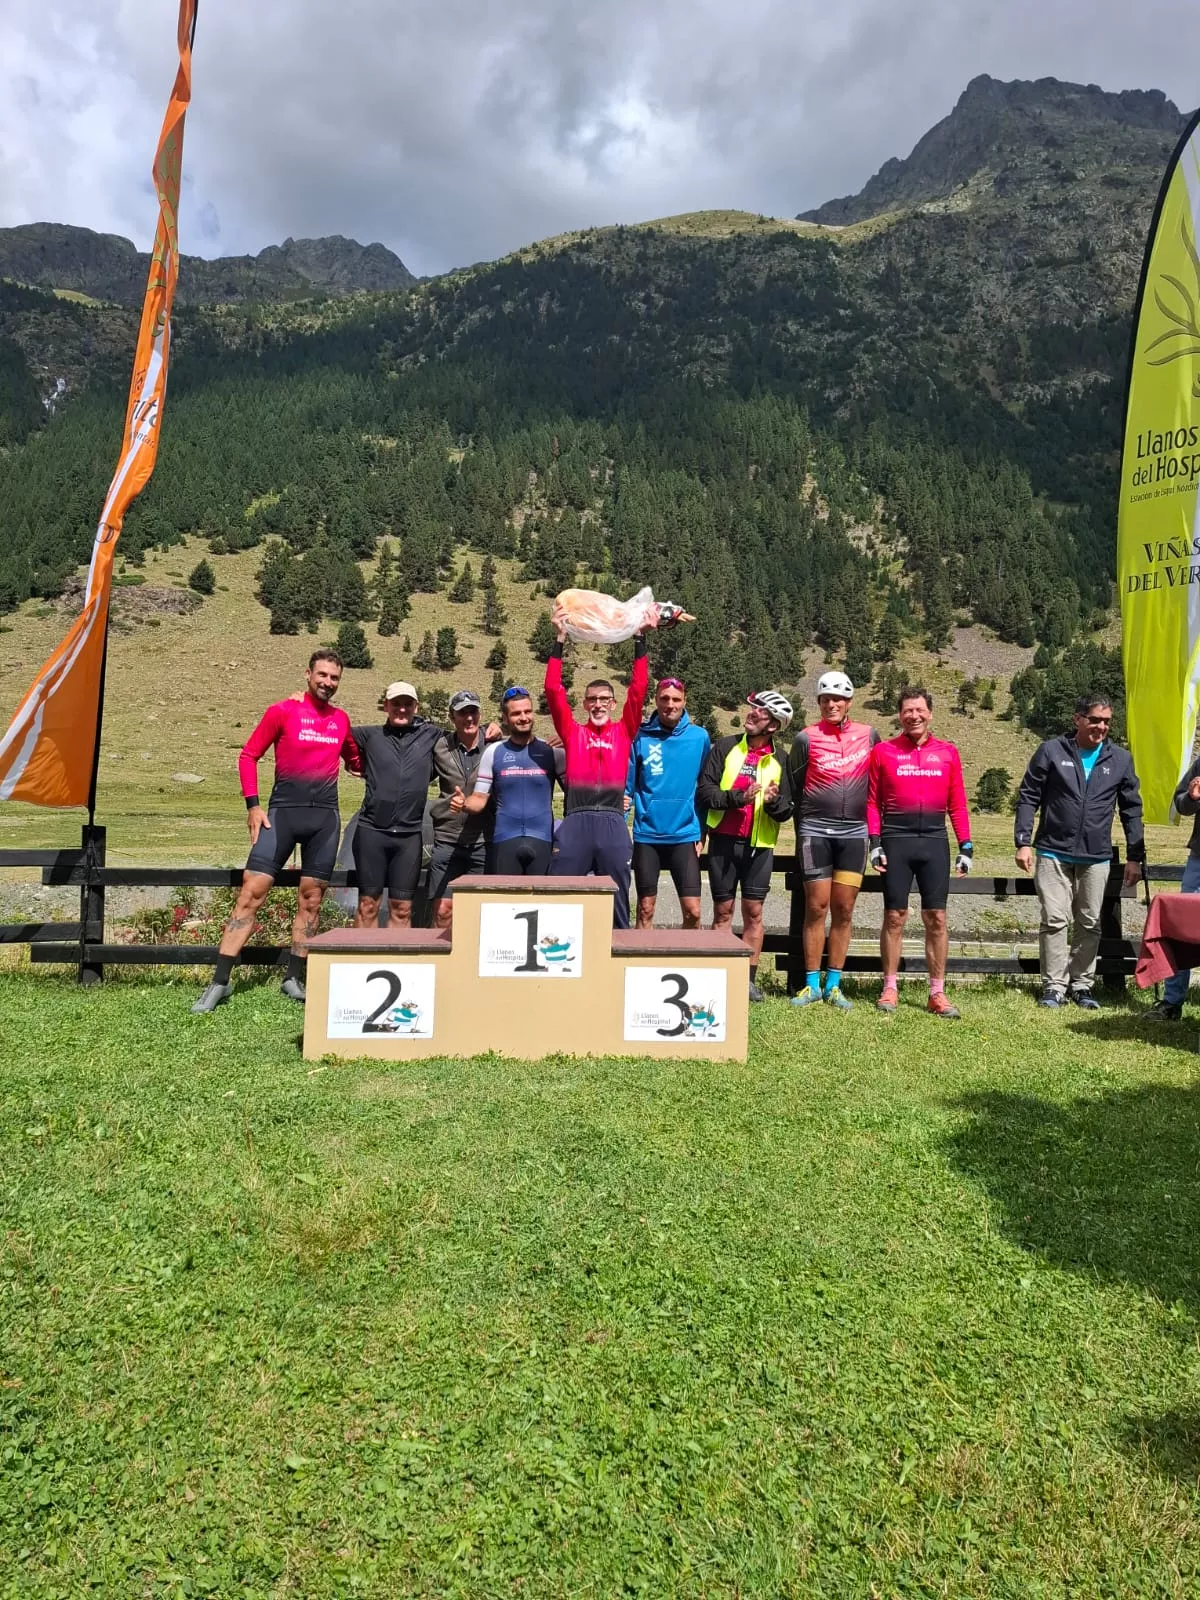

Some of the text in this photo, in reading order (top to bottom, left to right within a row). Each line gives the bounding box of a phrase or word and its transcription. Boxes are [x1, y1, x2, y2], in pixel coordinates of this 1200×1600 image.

[1137, 426, 1199, 459] Llanos
[1132, 466, 1153, 486] del
[1127, 572, 1162, 593] DEL
[298, 732, 339, 744] benasque
[897, 768, 942, 777] benasque
[514, 909, 549, 972] 1
[362, 970, 402, 1033] 2
[656, 973, 694, 1037] 3
